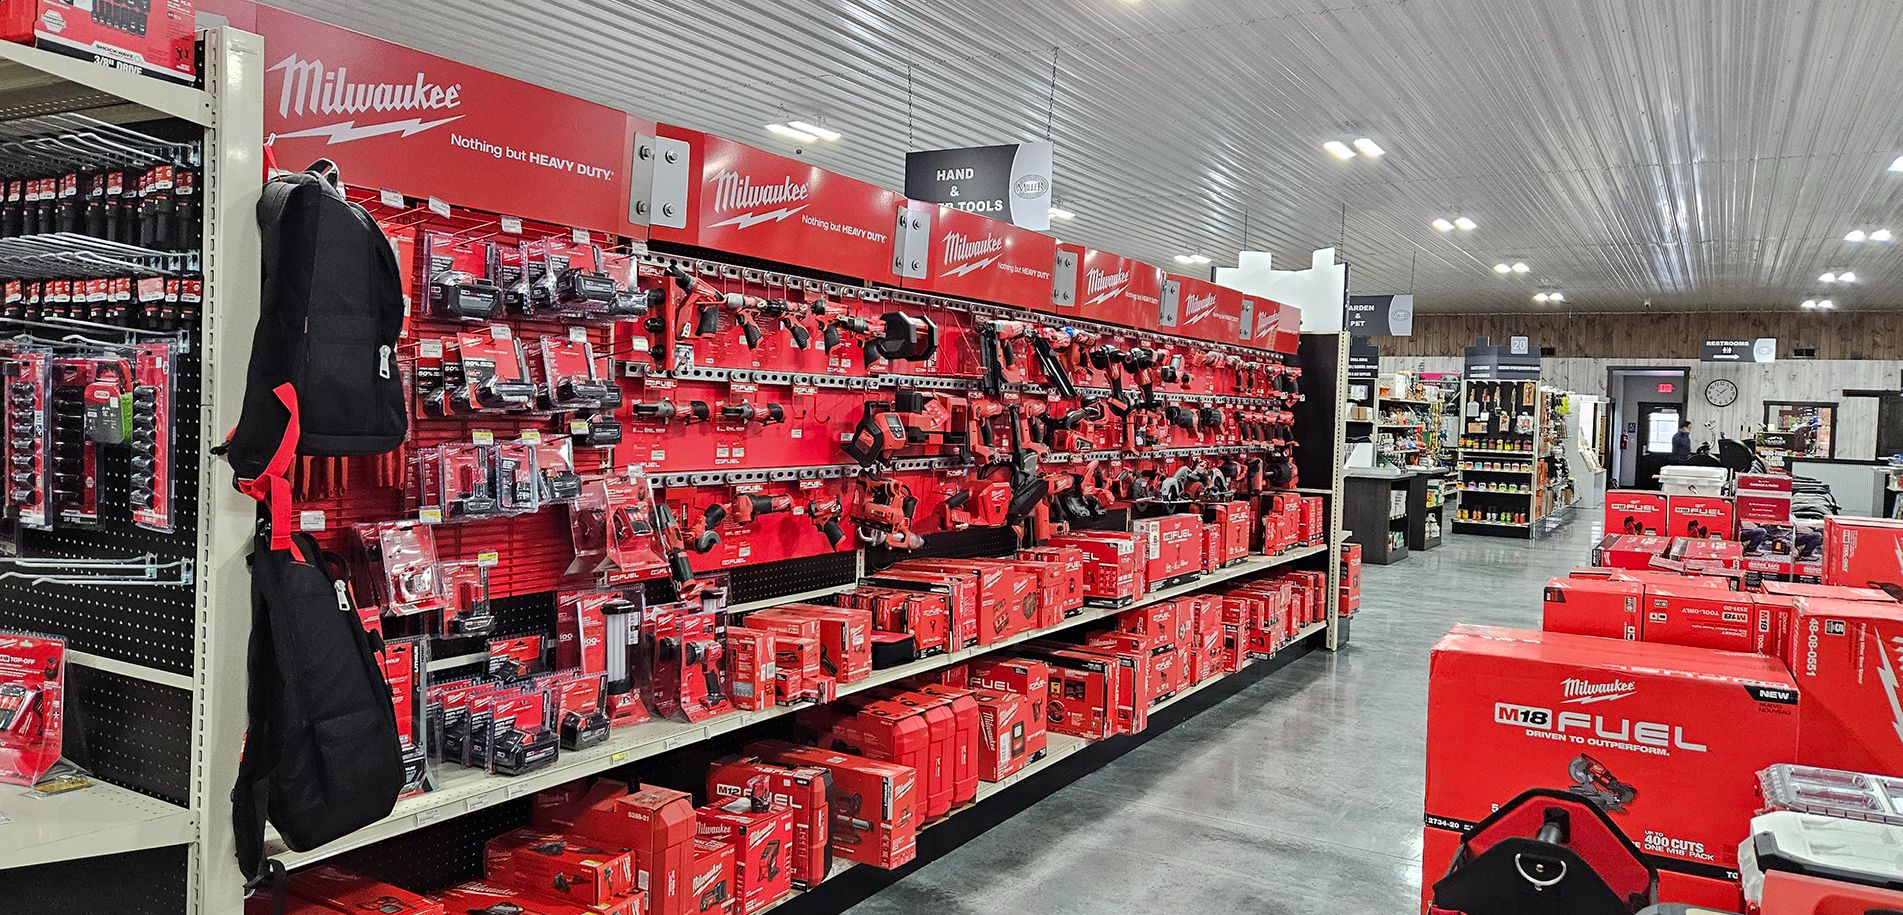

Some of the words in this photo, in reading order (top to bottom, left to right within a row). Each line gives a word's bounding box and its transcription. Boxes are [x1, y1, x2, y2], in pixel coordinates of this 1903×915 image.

[116, 61, 142, 75] DRIVE
[266, 53, 461, 118] Milwaukee
[451, 133, 502, 158] Nothing
[506, 146, 527, 162] but
[529, 151, 573, 172] HEAVY
[936, 168, 974, 181] HAND
[707, 168, 810, 214] Milwaukee
[949, 185, 960, 197] &
[958, 200, 1004, 212] TOOLS
[801, 214, 829, 231] Nothing
[830, 221, 843, 232] but
[842, 224, 867, 240] HEAVY
[941, 230, 1004, 267] Milwaukee
[1086, 267, 1130, 295] Milwaukee
[1513, 340, 1526, 350] 20
[1626, 503, 1660, 511] FUEL
[1172, 529, 1193, 540] FUEL
[1681, 608, 1719, 617] TOOL-ONLY
[1723, 613, 1748, 623] M18
[1760, 610, 1769, 632] M18
[1834, 623, 1845, 633] 5
[1806, 617, 1819, 677] 48-08-0551
[10, 657, 35, 665] TOP-OFF
[969, 676, 1018, 693] FUEL
[1560, 677, 1636, 698] Milwaukee
[1759, 689, 1790, 701] NEW
[983, 711, 995, 752] Milwaukee
[1499, 705, 1549, 726] M18
[1557, 711, 1708, 753] FUEL
[1526, 729, 1566, 742] DRIVEN
[1569, 734, 1585, 744] TO
[1587, 737, 1670, 757] OUTPERFORM.
[717, 785, 741, 795] M12
[743, 789, 803, 809] FEL
[1428, 817, 1460, 829] 2734-20
[1644, 835, 1669, 847] 400
[1671, 838, 1704, 853] CUTS
[1644, 843, 1664, 853] ONE
[1666, 847, 1685, 856] M18
[1689, 851, 1714, 861] PACK
[692, 862, 723, 888] Milwaukee
